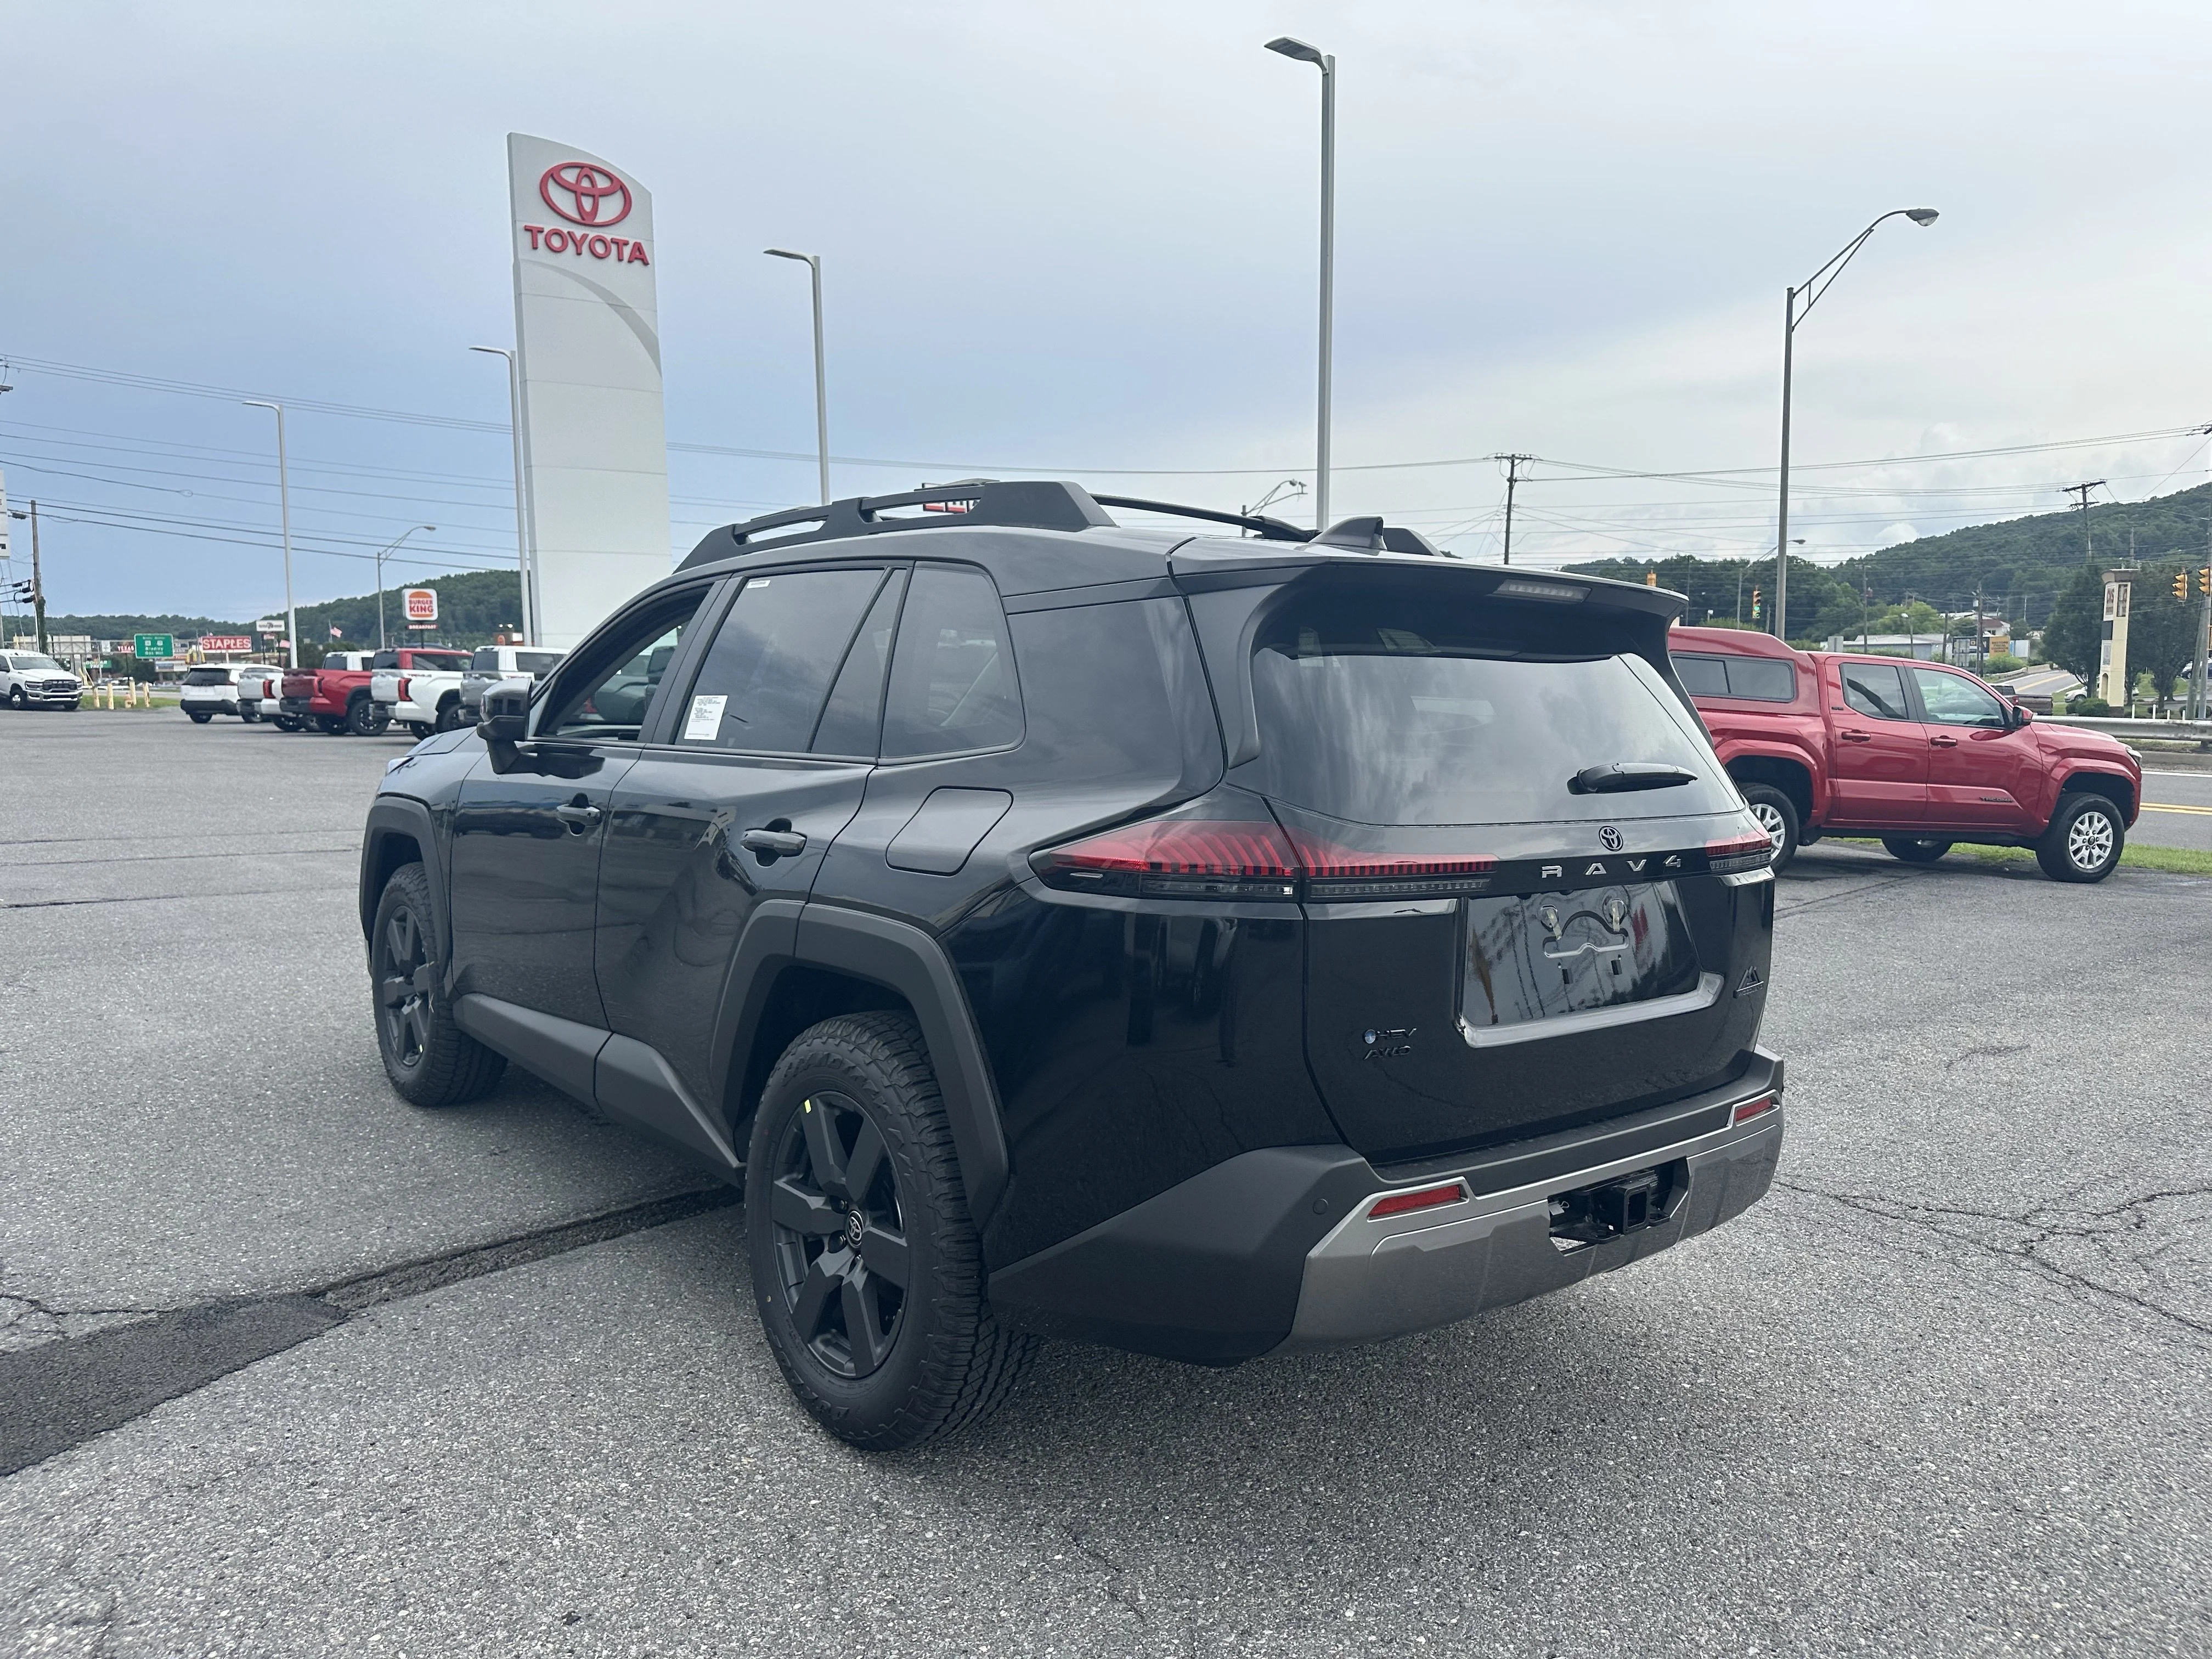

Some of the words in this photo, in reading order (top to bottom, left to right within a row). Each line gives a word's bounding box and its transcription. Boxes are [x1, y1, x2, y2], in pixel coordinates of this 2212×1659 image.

[523, 224, 650, 266] TOYOTA
[202, 638, 251, 649] STAPLES
[1541, 855, 1681, 879] RAV4
[1363, 1045, 1411, 1060] AWD
